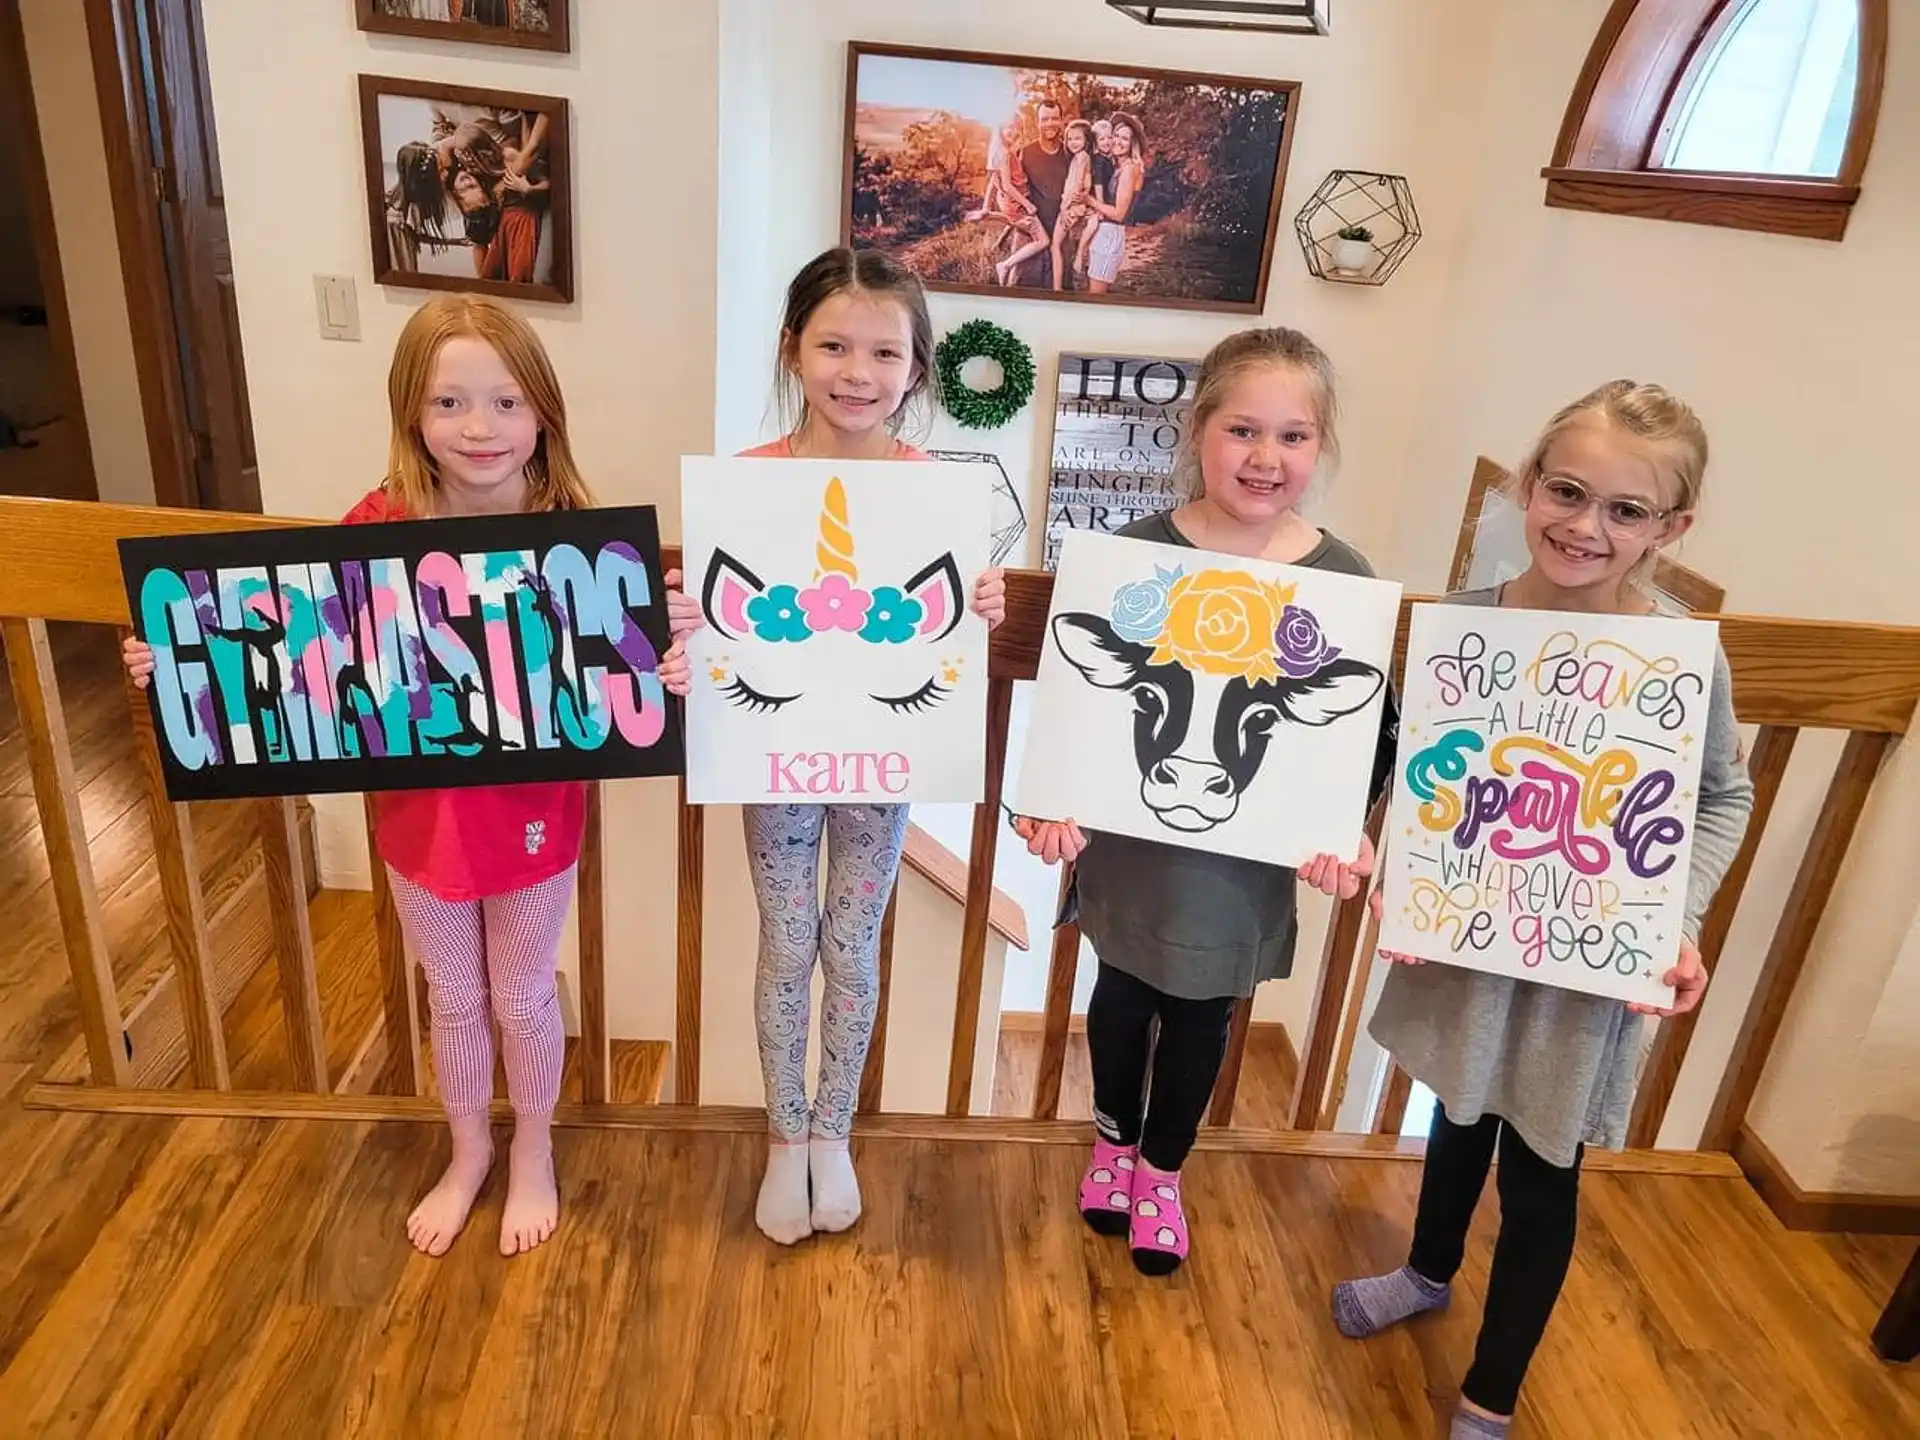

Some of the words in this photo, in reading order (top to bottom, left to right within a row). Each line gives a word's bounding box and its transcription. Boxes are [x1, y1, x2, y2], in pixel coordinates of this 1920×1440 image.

[1077, 358, 1187, 405] HO
[1121, 406, 1188, 424] PLAC
[1119, 423, 1181, 449] TO
[1118, 449, 1152, 463] ON
[1132, 463, 1172, 477] CRO
[1053, 472, 1175, 496] FINGER
[1050, 491, 1101, 504] SHINE
[140, 540, 666, 772] GYMNASTICS
[1426, 632, 1517, 706] she
[1524, 631, 1703, 730] leaves
[1488, 701, 1509, 736] A
[1512, 914, 1653, 976] goes
